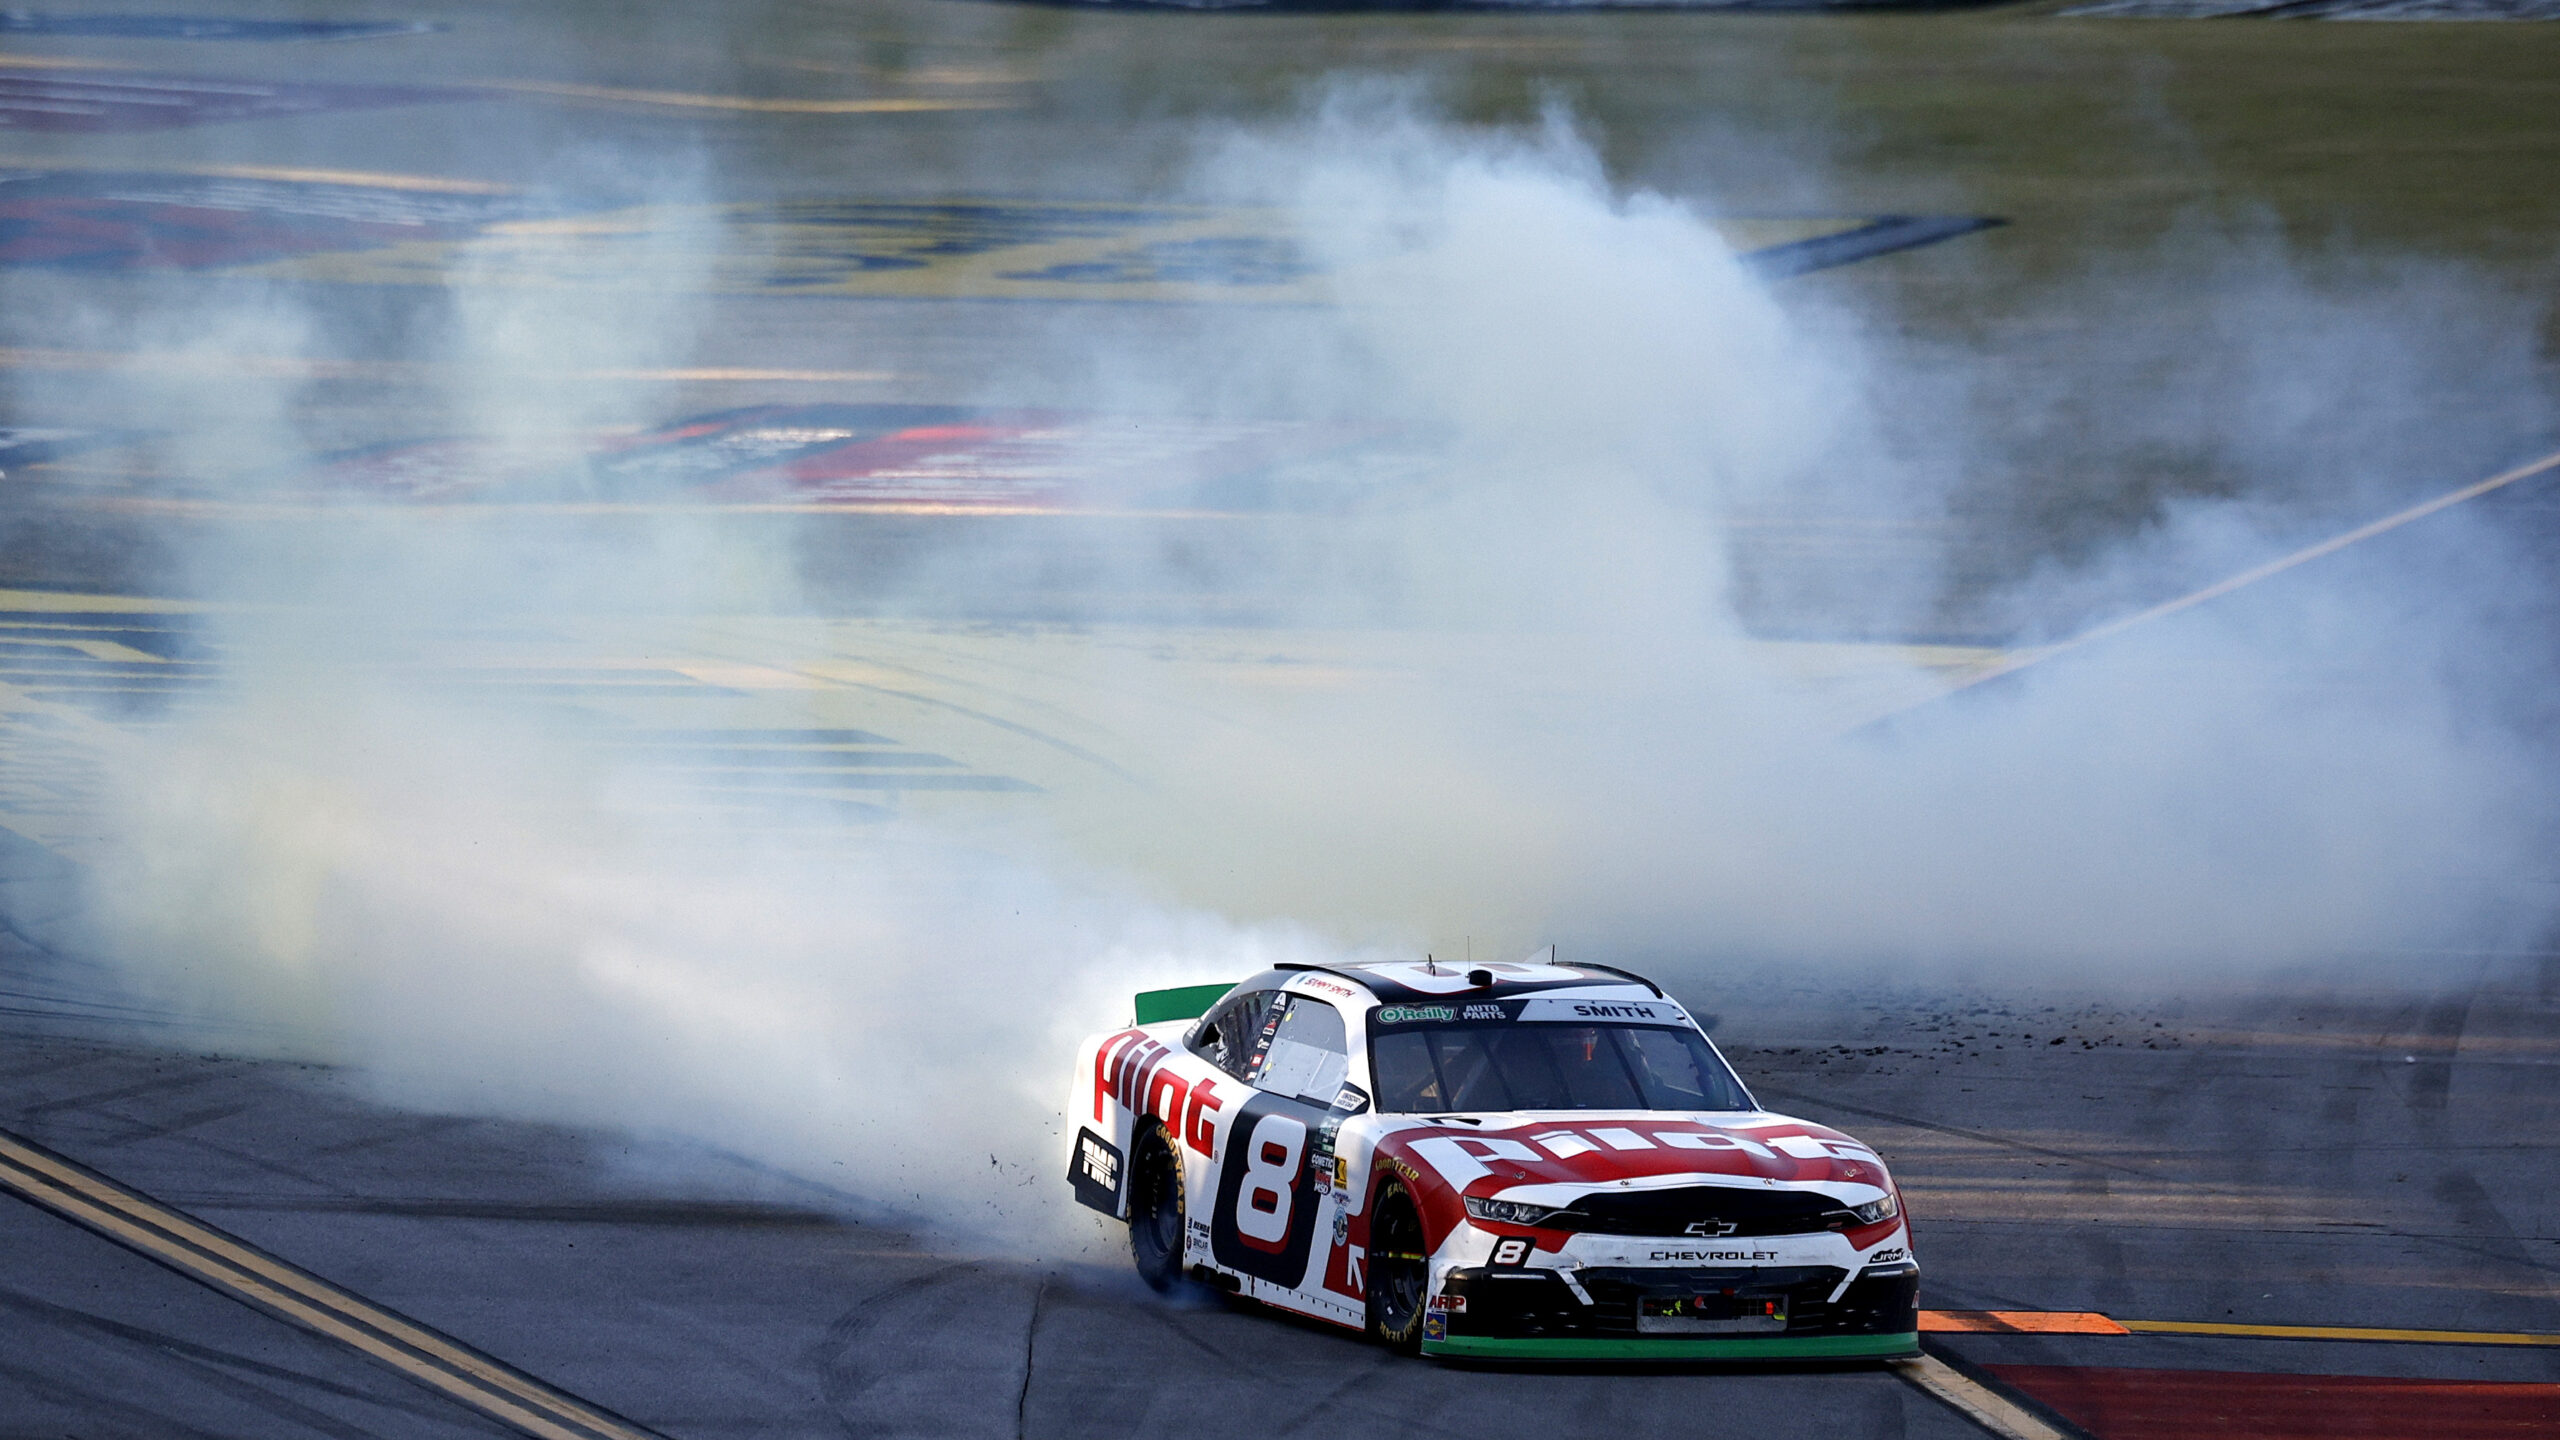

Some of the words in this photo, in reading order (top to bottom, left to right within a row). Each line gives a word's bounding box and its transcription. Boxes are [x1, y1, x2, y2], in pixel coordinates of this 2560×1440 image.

[1380, 1006, 1455, 1022] O'Reilly
[1463, 1011, 1507, 1020] PARTS
[1465, 1004, 1500, 1012] AUTO
[1573, 1004, 1656, 1019] SMITH
[1093, 1028, 1224, 1160] pilot
[1311, 1153, 1334, 1169] COMETIC
[1406, 1127, 1882, 1195] pilot
[1375, 1156, 1420, 1182] GOODYEAR
[1236, 1113, 1308, 1250] 8
[1313, 1182, 1330, 1195] MSD
[1494, 1240, 1527, 1265] 8
[1650, 1251, 1779, 1261] CHEVROLET
[1871, 1250, 1903, 1262] JRM
[1429, 1295, 1466, 1309] ARP
